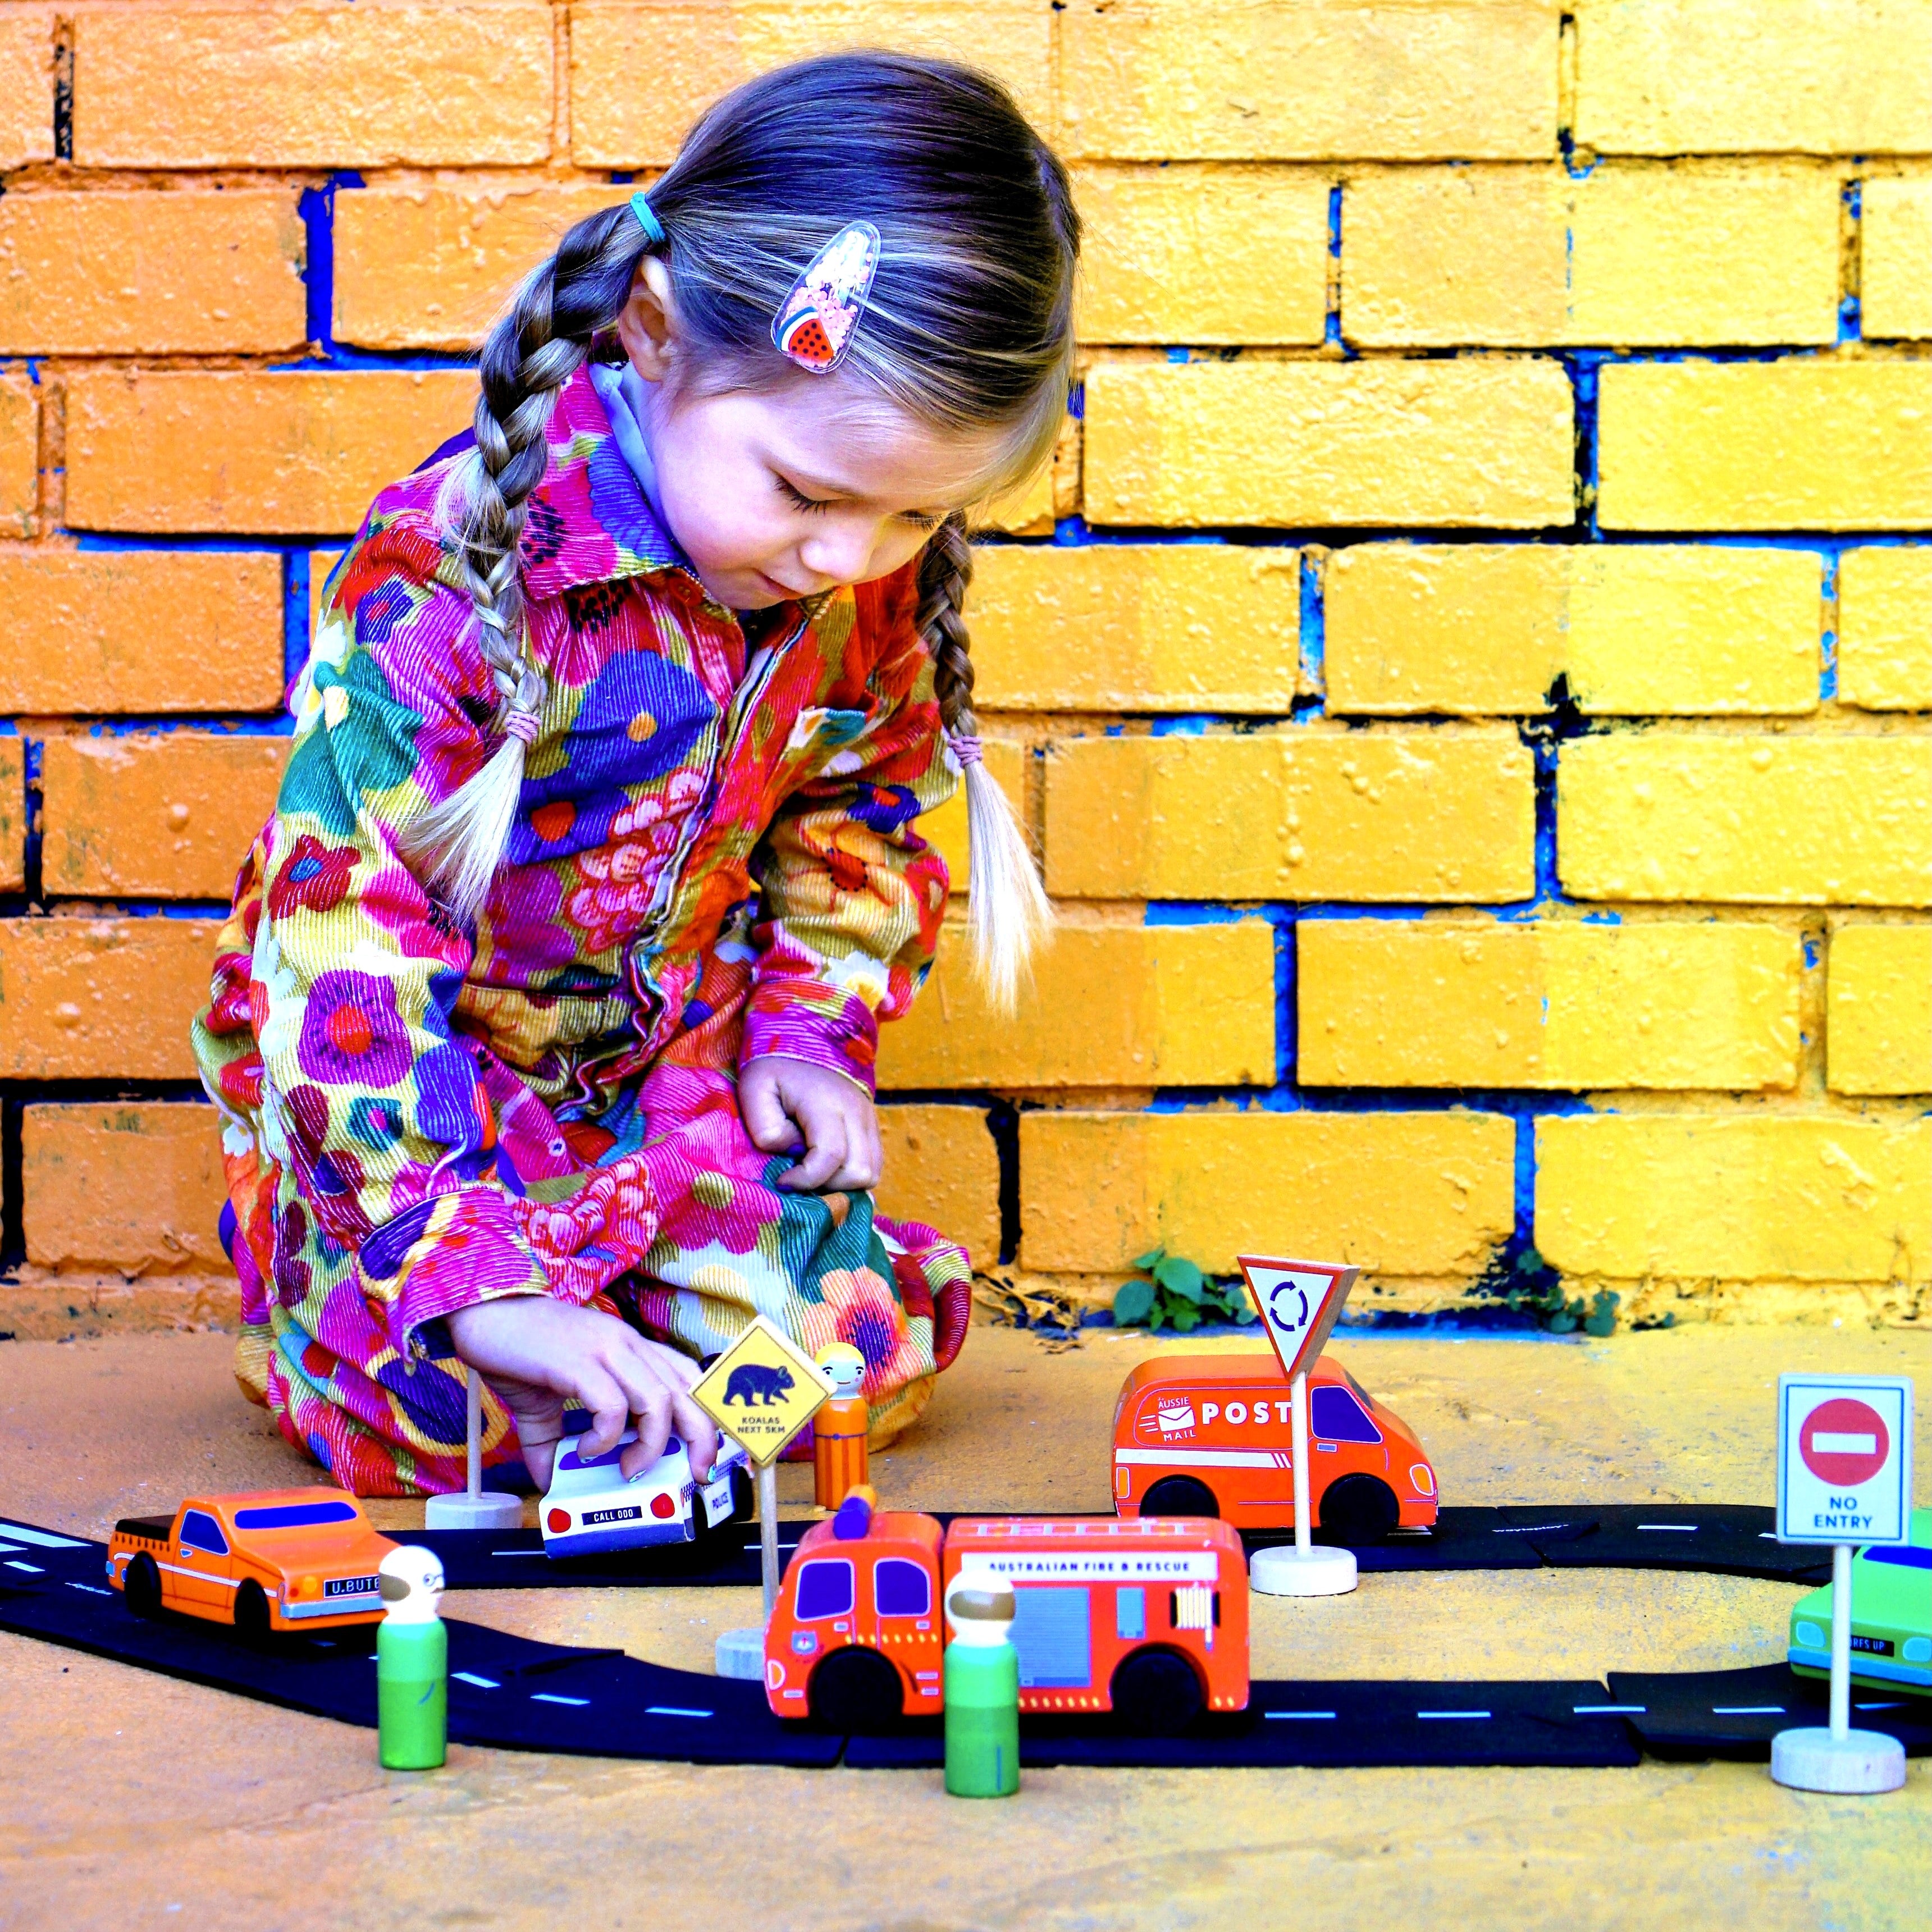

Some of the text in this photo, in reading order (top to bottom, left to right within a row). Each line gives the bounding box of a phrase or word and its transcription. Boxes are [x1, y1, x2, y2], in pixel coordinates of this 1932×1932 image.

[1202, 1401, 1291, 1424] POST
[1163, 1429, 1196, 1441] MAIL
[1830, 1496, 1857, 1510] NO
[593, 1511, 615, 1522] CALL
[1814, 1514, 1872, 1528] ENTRY
[989, 1561, 1078, 1572] AUSTRALIAN
[1084, 1561, 1113, 1572] FIRE
[1136, 1561, 1189, 1572] RESCUE
[1850, 1638, 1885, 1651] RFS UP
